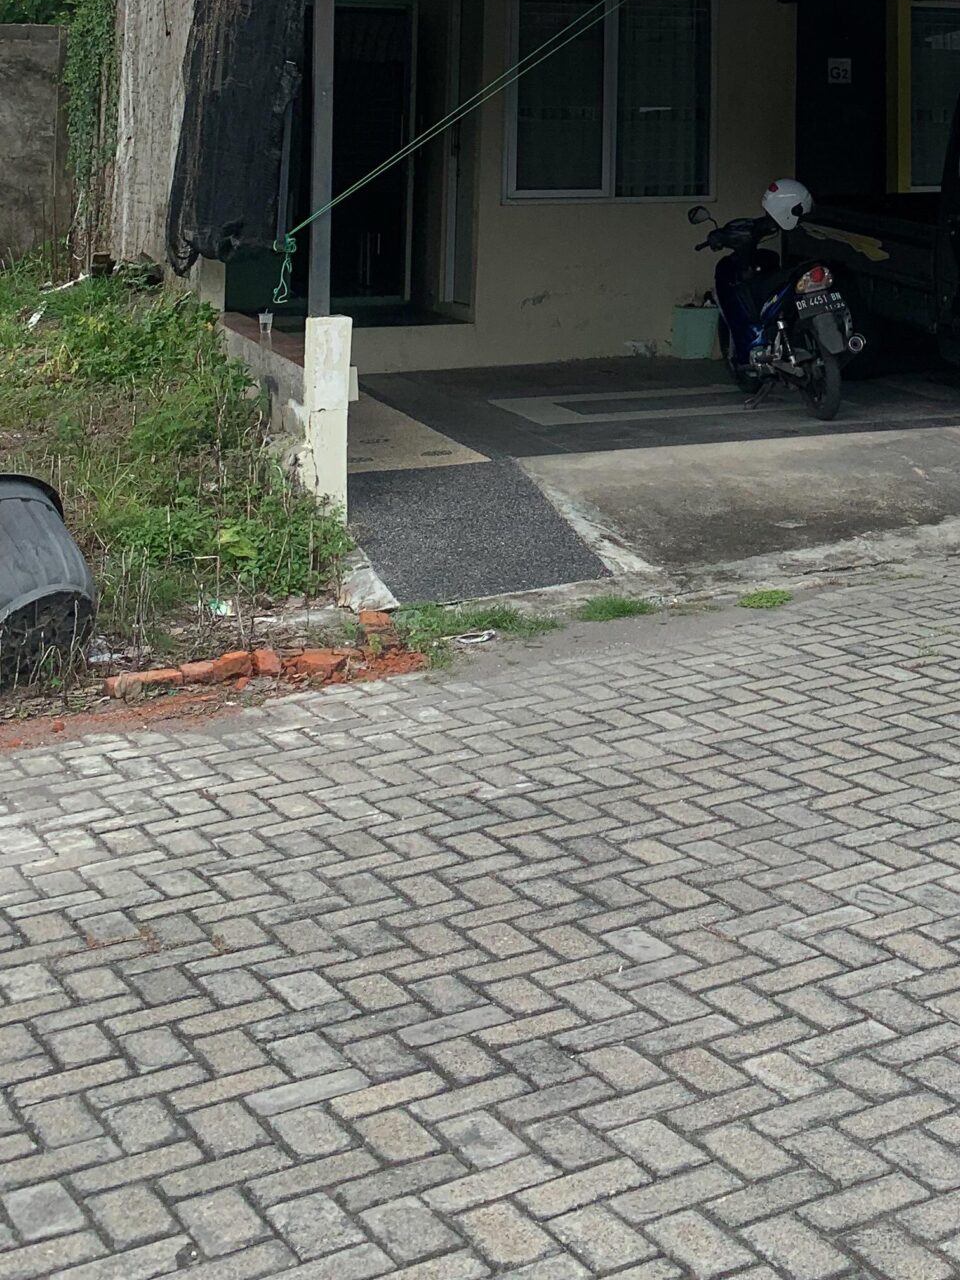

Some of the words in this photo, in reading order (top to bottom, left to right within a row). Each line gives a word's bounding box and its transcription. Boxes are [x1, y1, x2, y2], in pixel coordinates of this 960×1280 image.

[830, 66, 849, 80] G2
[796, 299, 808, 310] DR
[810, 294, 828, 306] 4451
